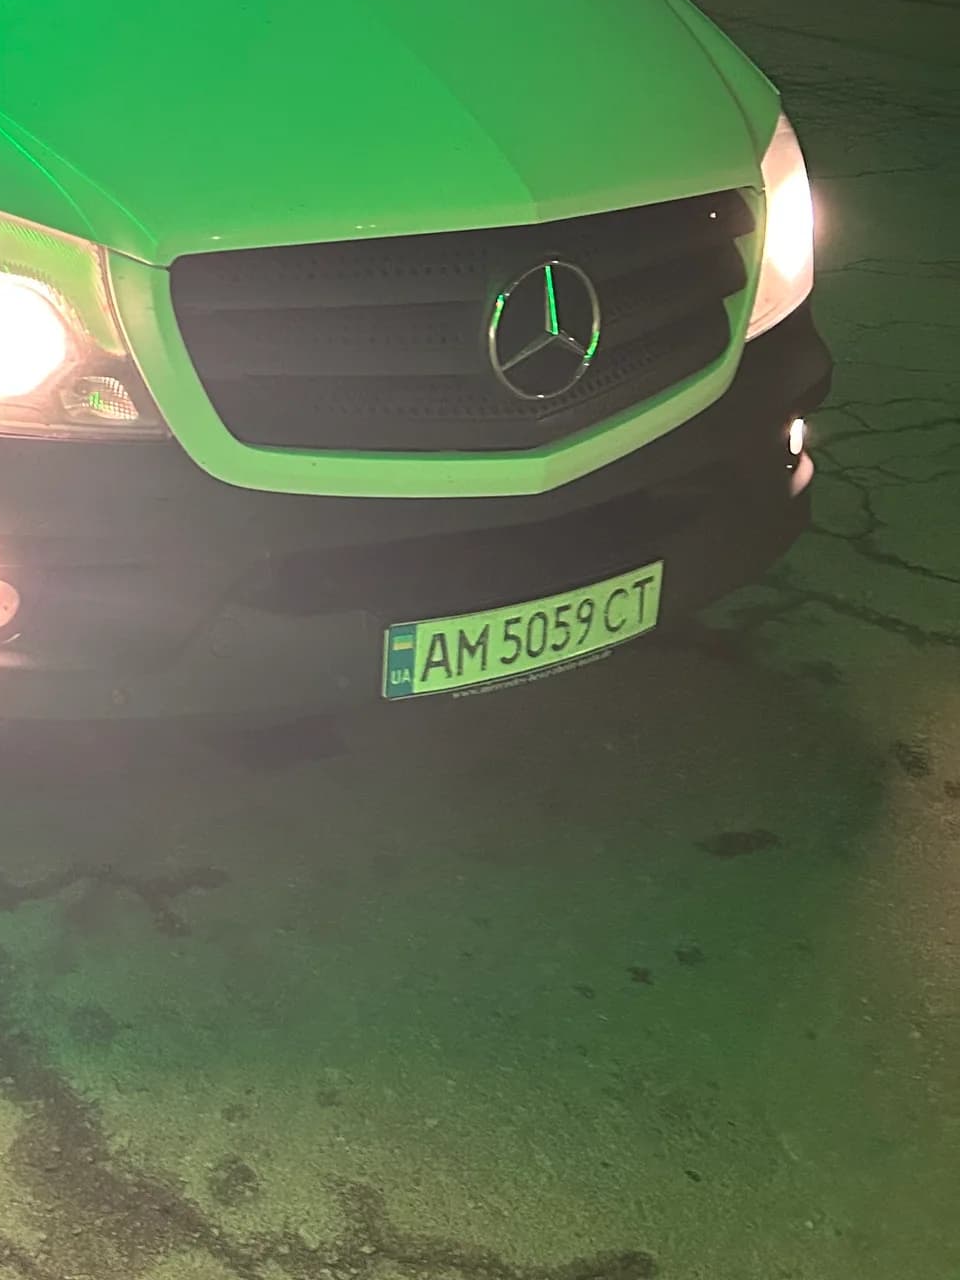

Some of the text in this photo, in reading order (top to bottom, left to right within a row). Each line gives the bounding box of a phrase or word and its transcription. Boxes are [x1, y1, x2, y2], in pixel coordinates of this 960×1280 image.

[420, 623, 490, 682] AM
[499, 598, 595, 665] 5059
[602, 575, 655, 633] CT
[390, 668, 411, 685] UA
